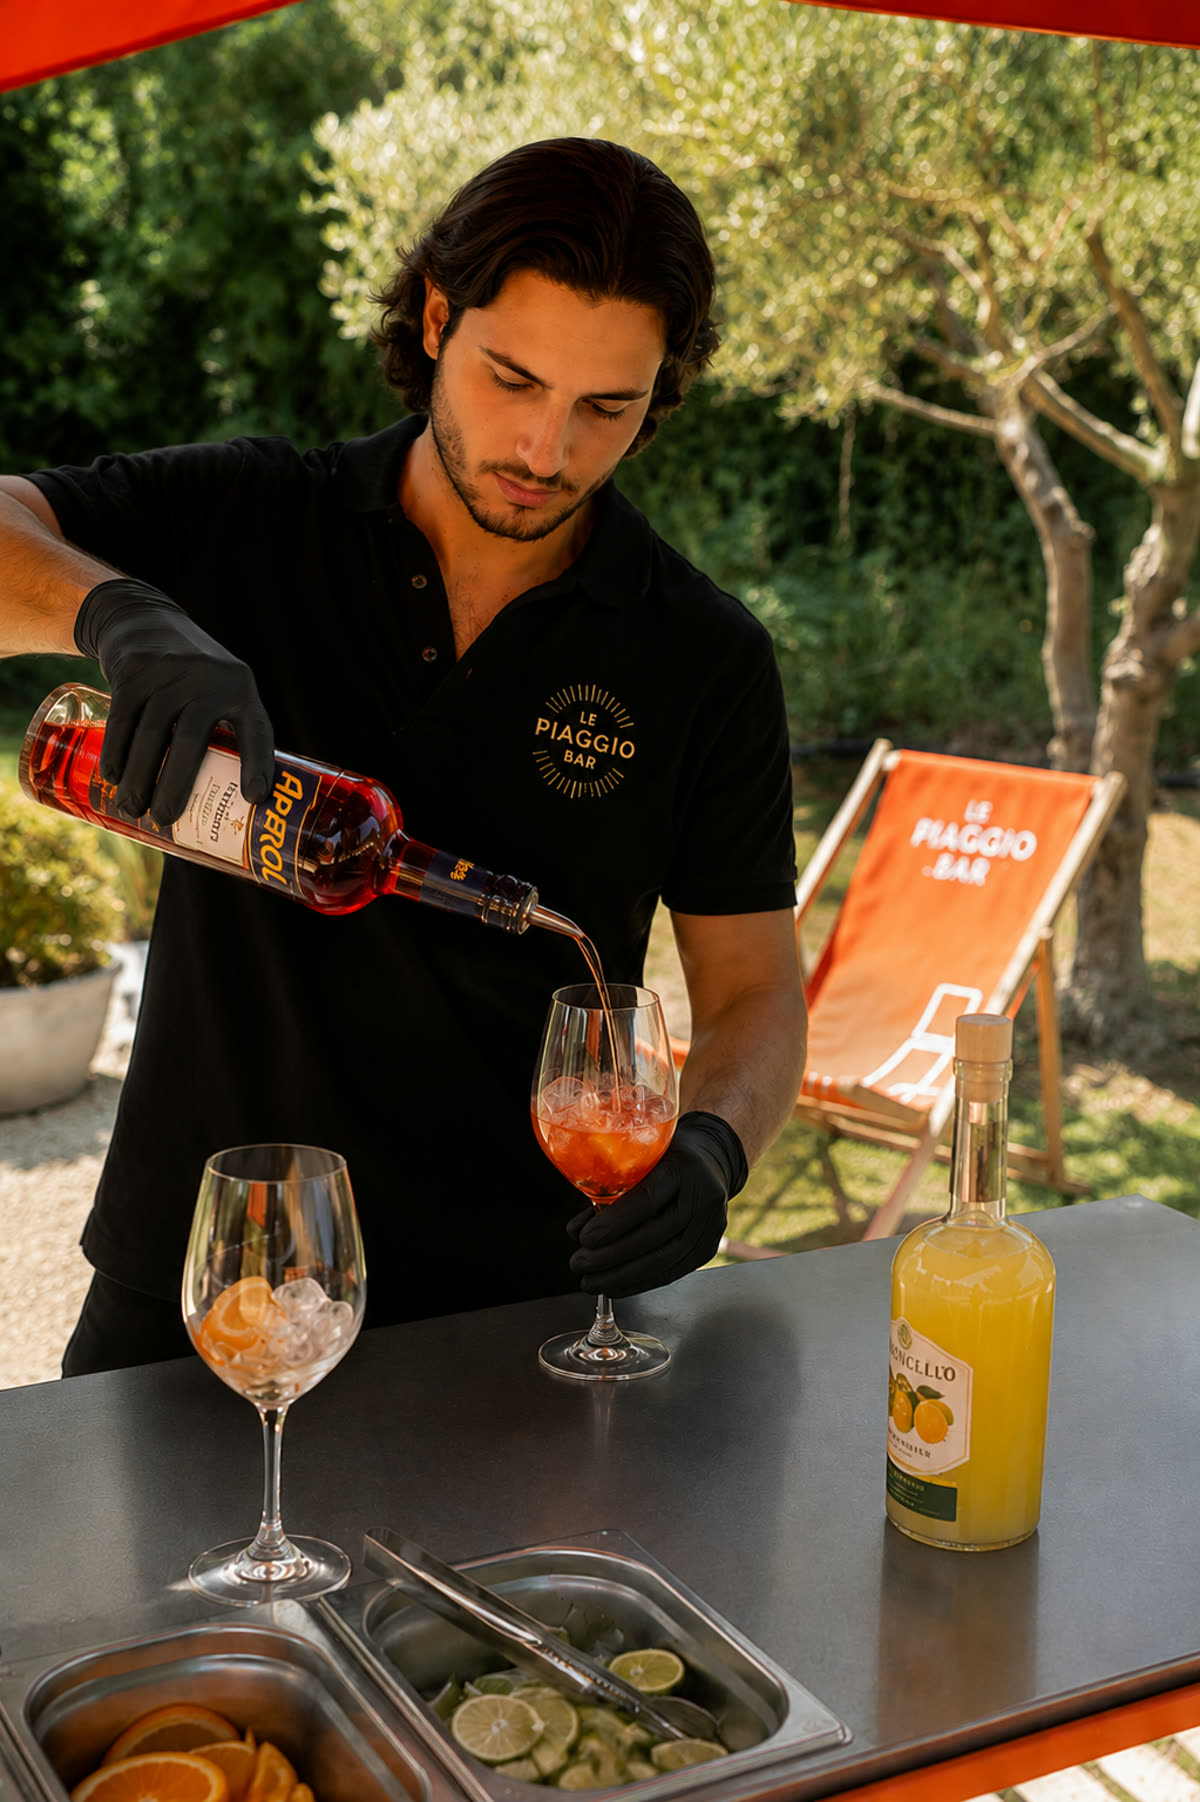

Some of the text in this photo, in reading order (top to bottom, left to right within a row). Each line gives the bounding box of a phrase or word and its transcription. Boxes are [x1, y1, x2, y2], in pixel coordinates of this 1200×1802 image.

[580, 711, 598, 727] LE
[535, 717, 636, 759] PIAGGIO
[563, 749, 597, 770] BAR
[259, 770, 304, 885] APEROL
[964, 799, 993, 825] LE
[910, 817, 1038, 861] PIAGGIO
[932, 852, 991, 887] BAR
